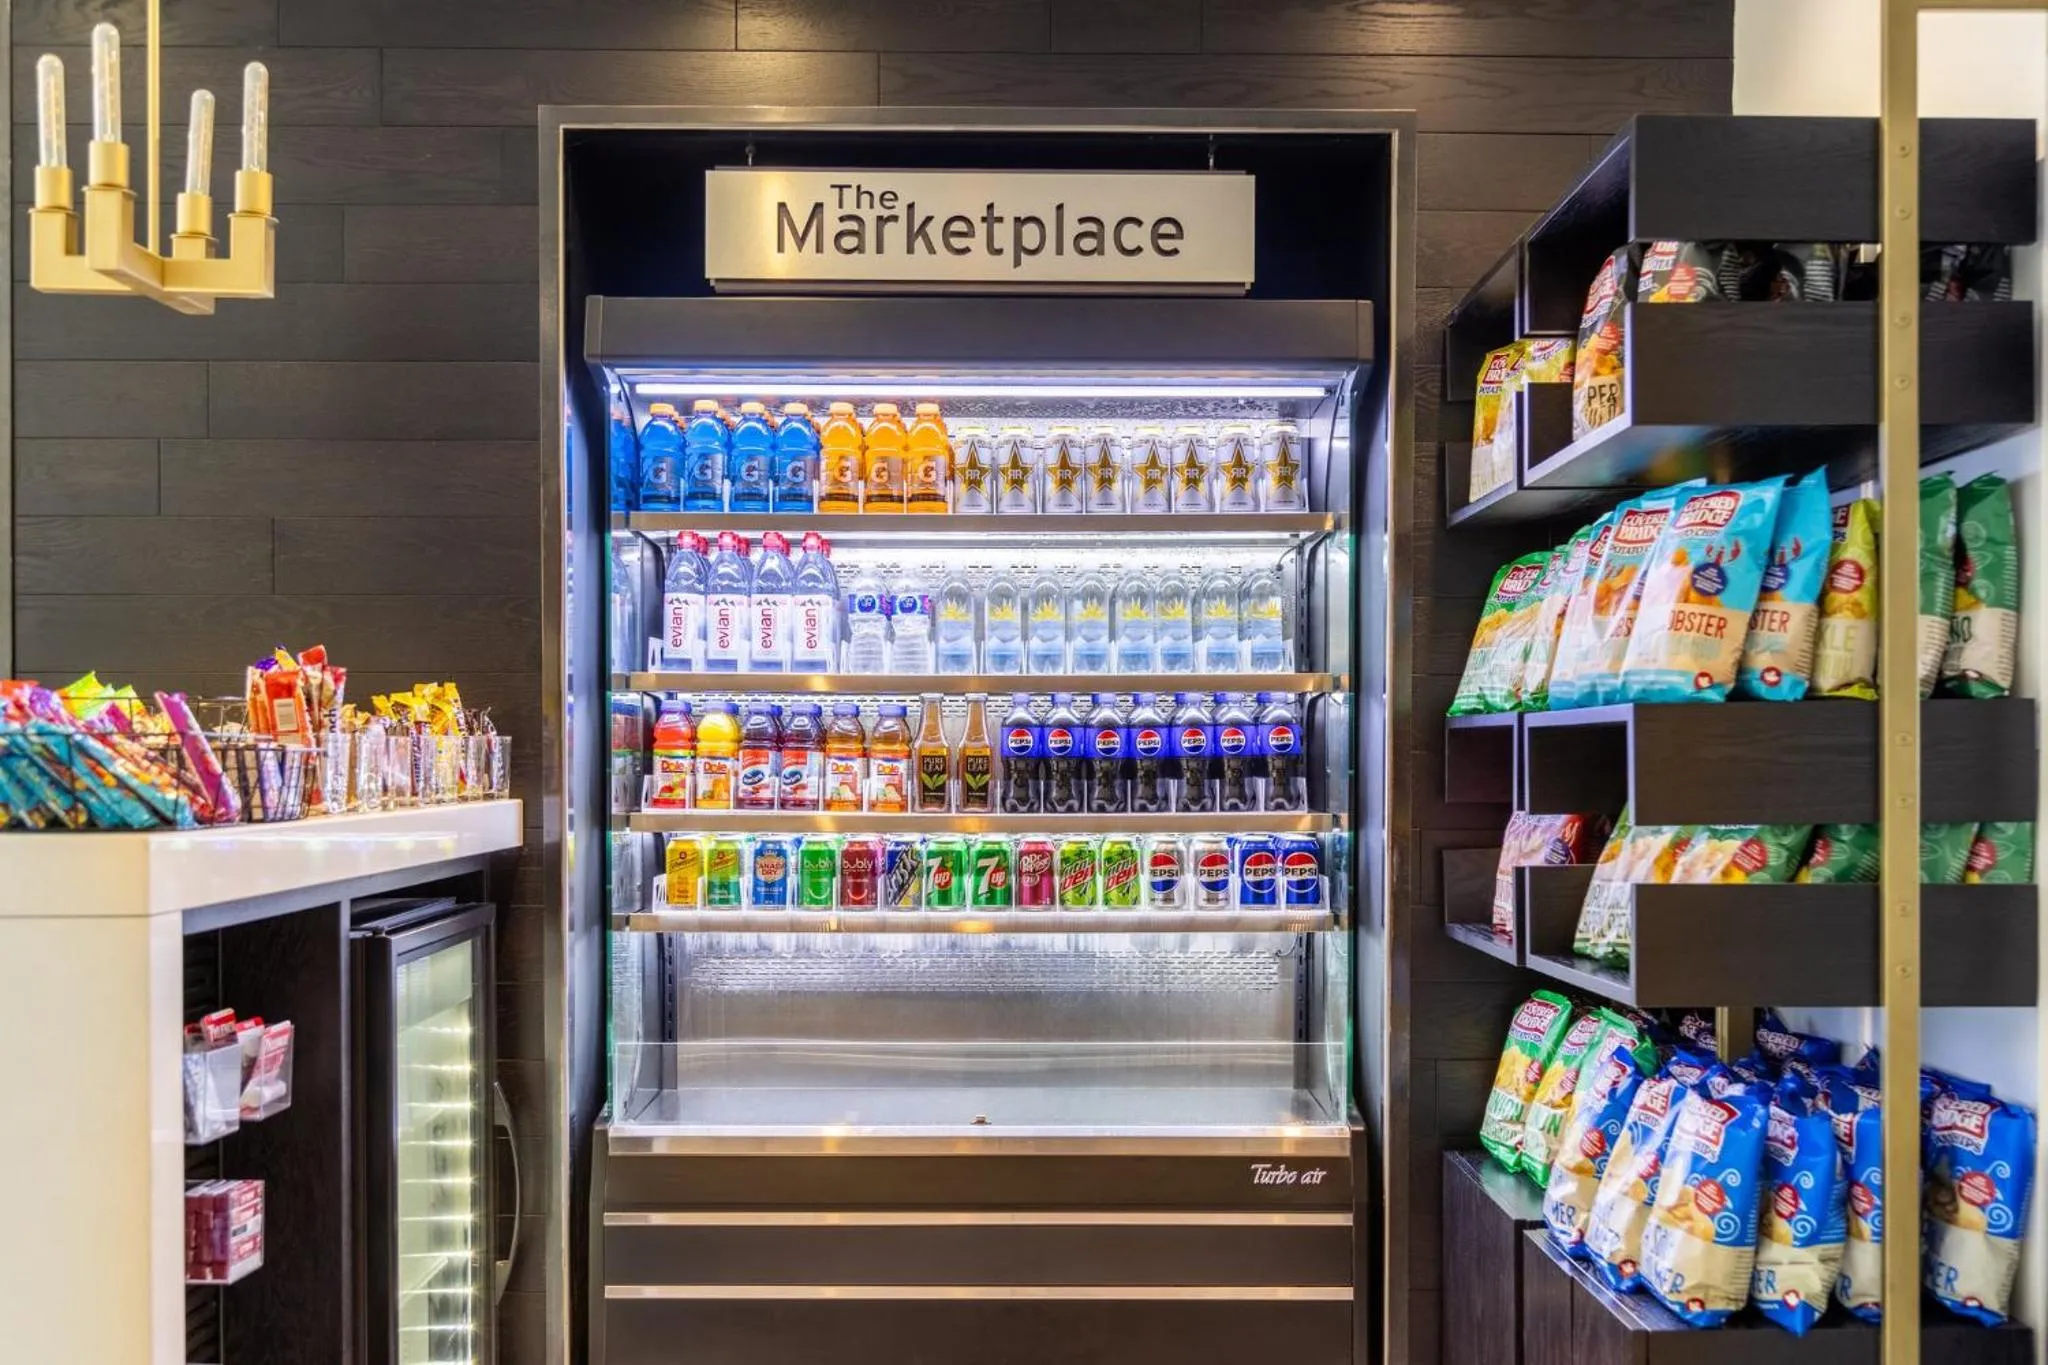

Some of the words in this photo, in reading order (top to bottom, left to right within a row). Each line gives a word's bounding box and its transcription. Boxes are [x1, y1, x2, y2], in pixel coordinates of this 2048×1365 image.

[830, 184, 899, 210] The
[776, 202, 1185, 268] Marketplace
[672, 606, 684, 648] evian
[716, 608, 730, 649] evian
[761, 608, 772, 649] evian
[806, 608, 817, 649] evian
[843, 857, 873, 872] bubly
[1250, 1164, 1298, 1184] Turbo
[1300, 1168, 1327, 1184] air
